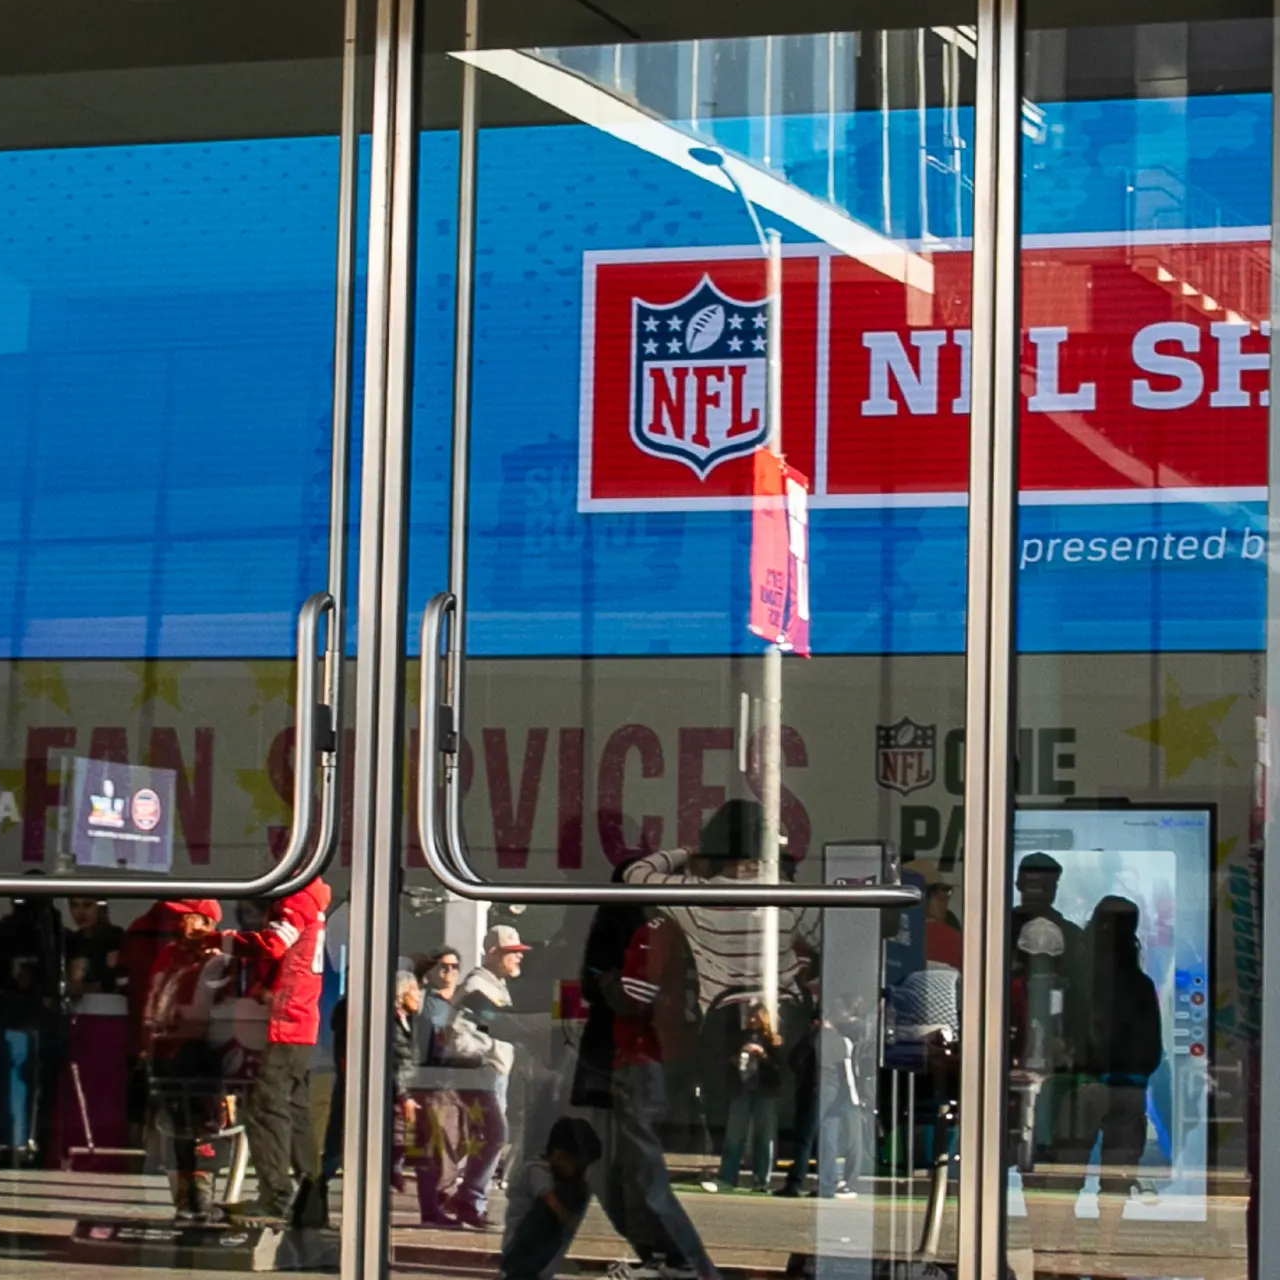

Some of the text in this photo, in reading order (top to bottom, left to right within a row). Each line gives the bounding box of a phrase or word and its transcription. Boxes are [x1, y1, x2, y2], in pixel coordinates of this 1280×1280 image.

[648, 365, 760, 449] NFL
[1020, 527, 1226, 570] presented
[23, 726, 214, 867] FAN
[880, 750, 930, 787] NFL
